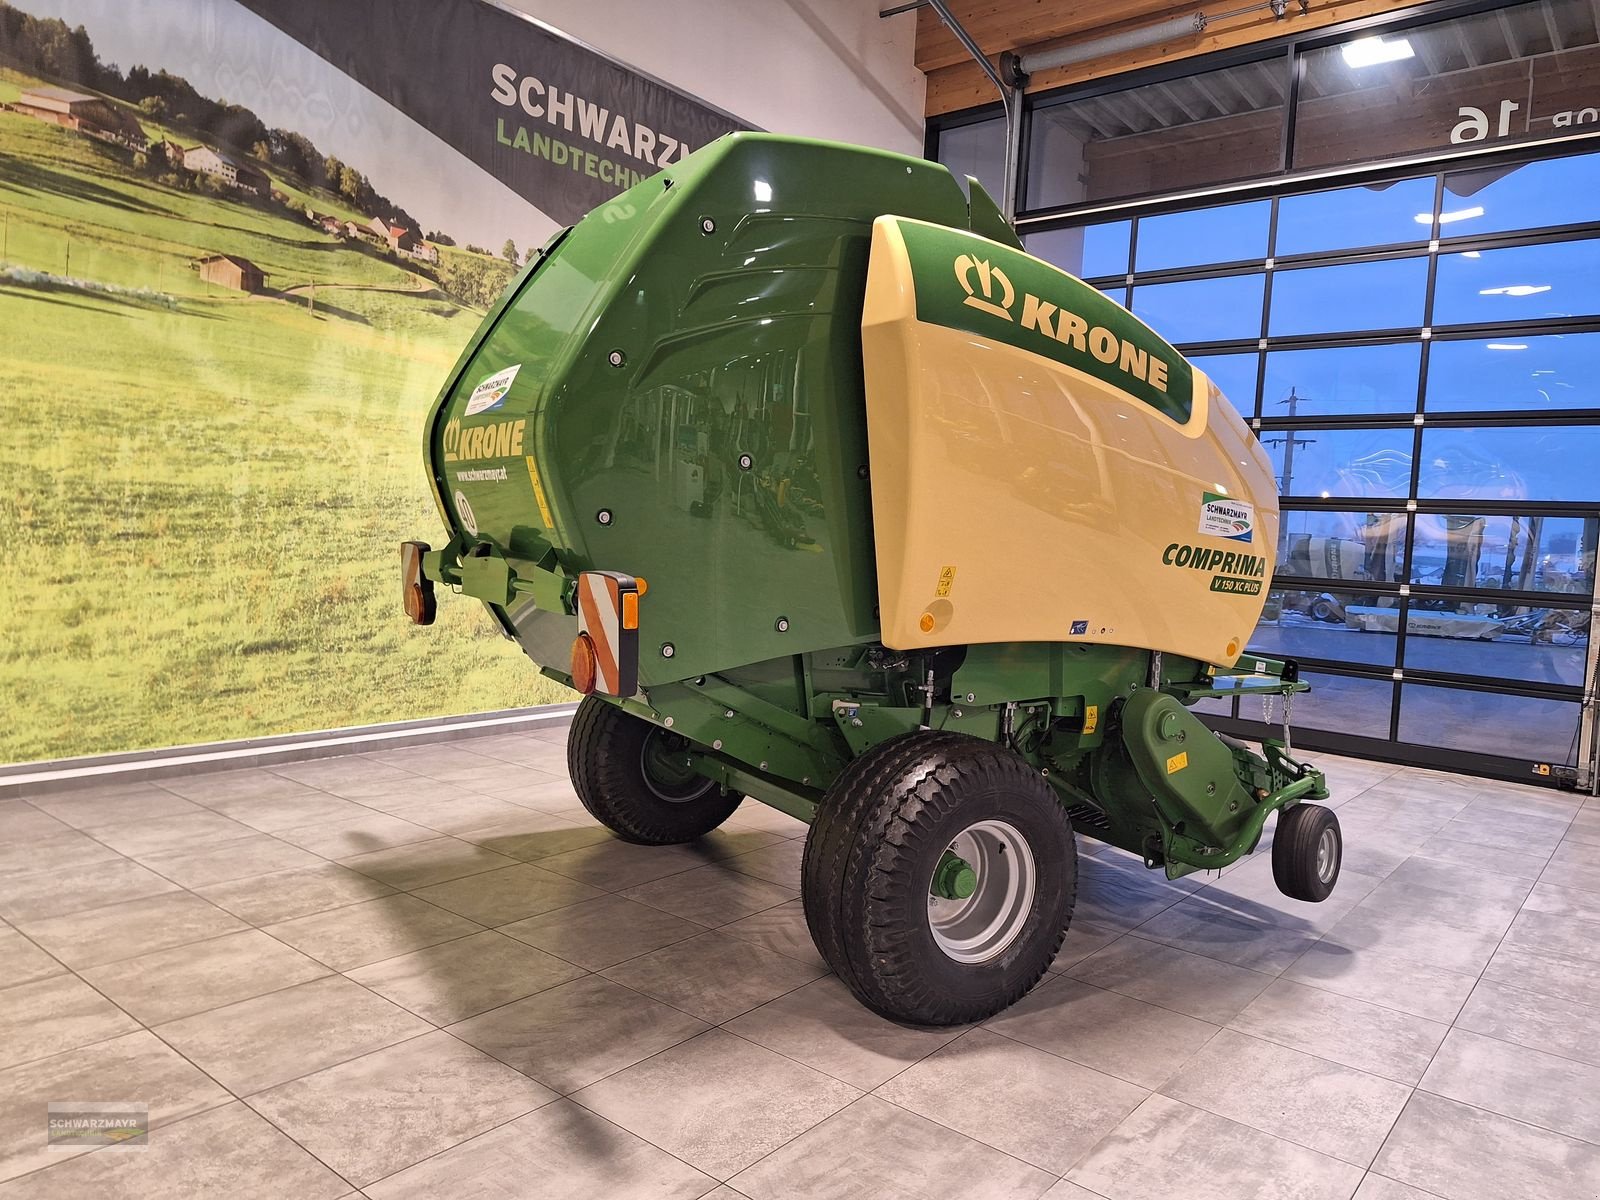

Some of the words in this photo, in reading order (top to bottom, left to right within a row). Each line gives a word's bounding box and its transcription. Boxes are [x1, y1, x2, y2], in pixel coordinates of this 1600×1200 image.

[1021, 293, 1168, 392] KRONE
[459, 419, 525, 460] KRONE
[1206, 504, 1247, 520] SCHWARZMAYR
[1162, 543, 1266, 578] COMPRIMA
[1214, 579, 1221, 589] V
[1221, 580, 1234, 591] 150
[1233, 581, 1244, 591] XC
[1243, 582, 1260, 593] PLUS
